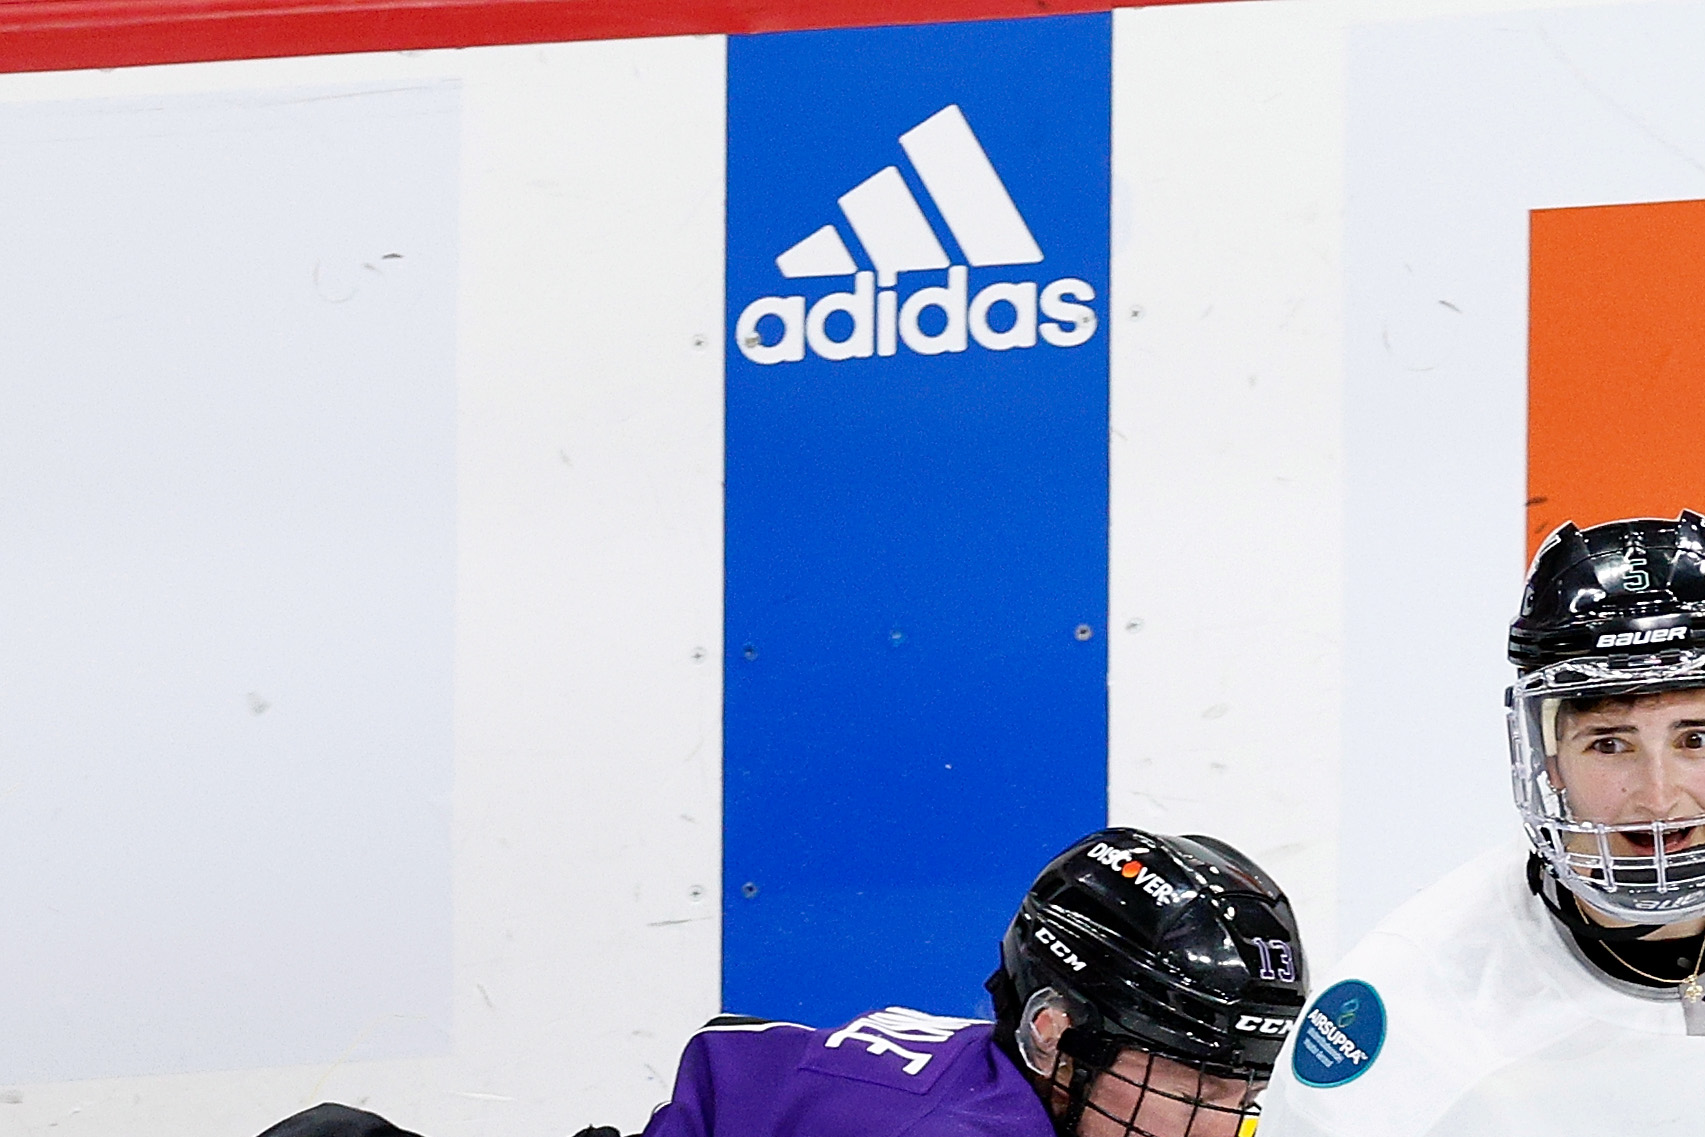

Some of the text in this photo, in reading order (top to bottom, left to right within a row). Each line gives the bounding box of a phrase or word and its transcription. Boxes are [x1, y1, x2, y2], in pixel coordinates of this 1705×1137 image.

[736, 265, 1098, 364] adidas
[1596, 626, 1688, 649] BAUER
[1087, 842, 1171, 905] DISCOVER
[1034, 927, 1087, 972] CCM
[1254, 937, 1296, 983] 13
[1308, 1009, 1368, 1065] AIRSUPRA
